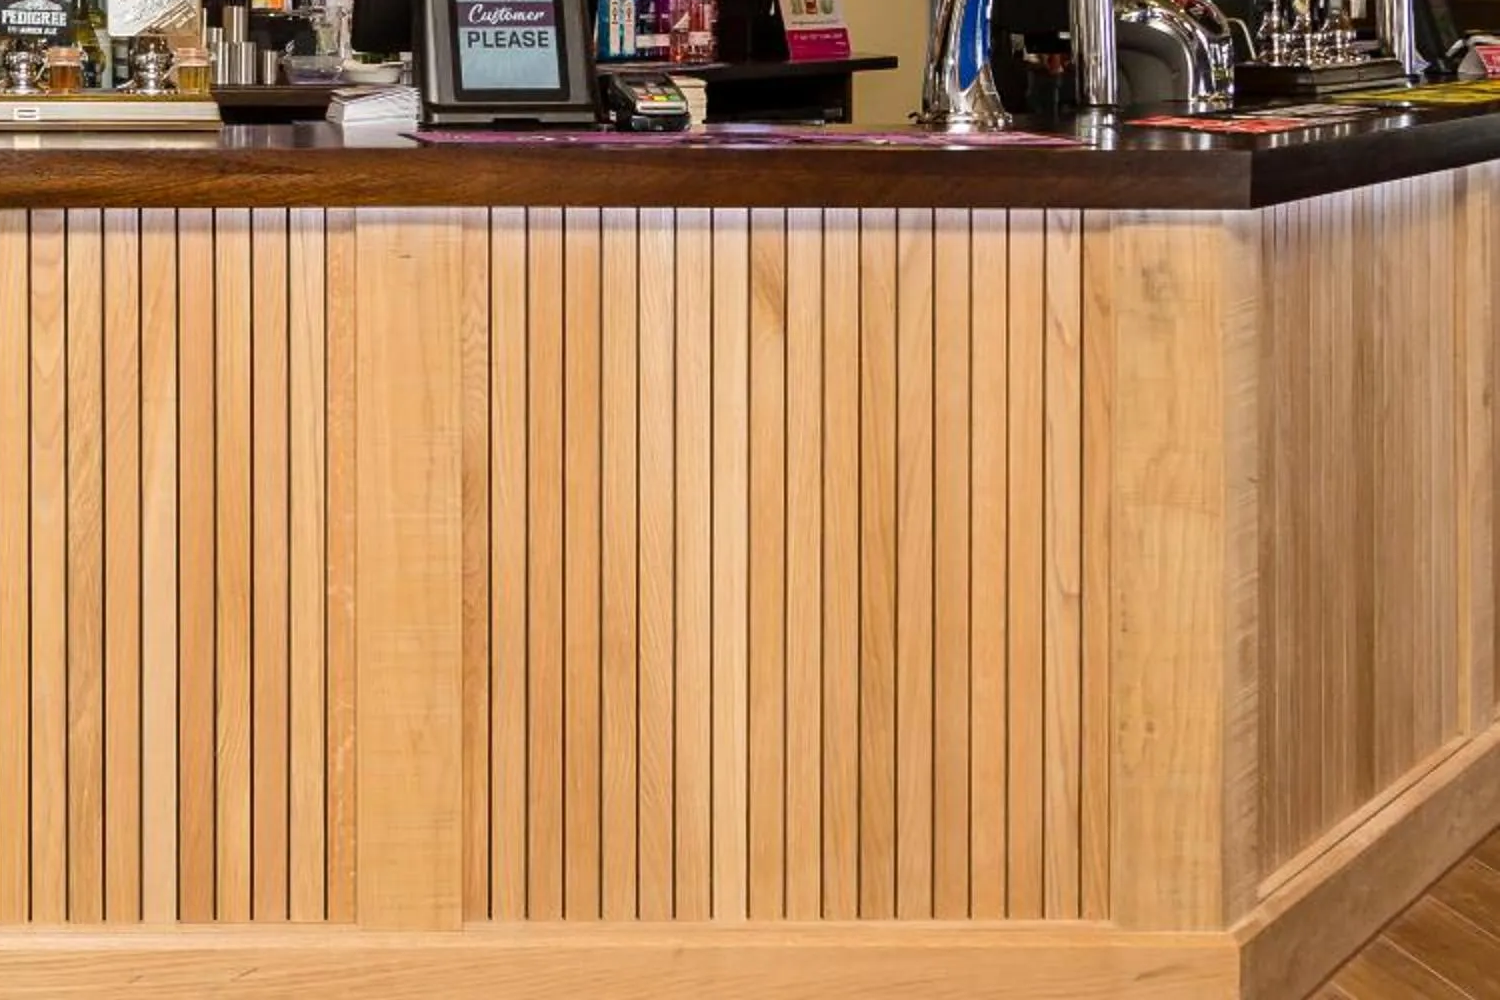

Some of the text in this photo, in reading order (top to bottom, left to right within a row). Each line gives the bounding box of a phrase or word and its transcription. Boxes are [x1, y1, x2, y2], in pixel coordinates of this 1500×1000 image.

[1, 9, 68, 27] PEDIGREE
[467, 3, 545, 25] Customer
[466, 30, 549, 49] PLEASE
